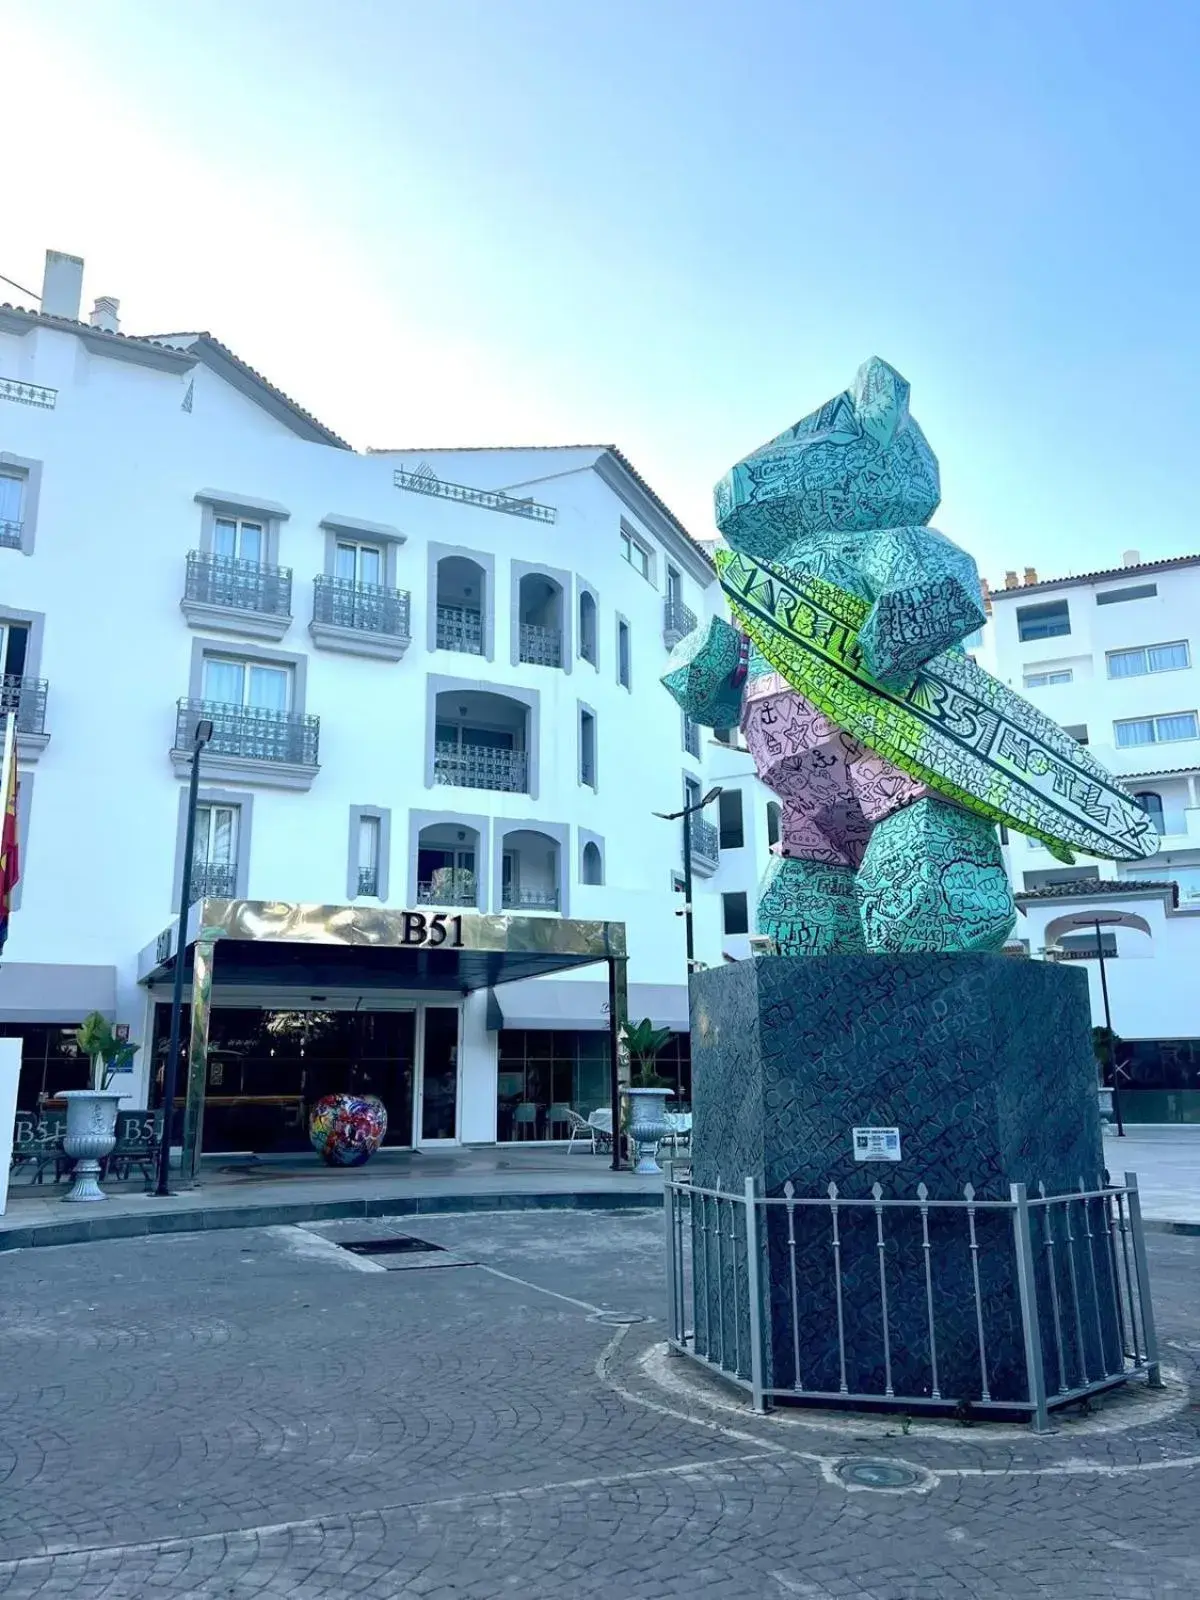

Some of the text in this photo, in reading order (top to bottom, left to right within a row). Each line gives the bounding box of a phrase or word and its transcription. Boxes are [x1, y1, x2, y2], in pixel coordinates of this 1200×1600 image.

[905, 670, 1000, 756] B51
[997, 727, 1111, 827] HOTEL
[401, 911, 464, 947] B51
[16, 1120, 62, 1143] B51
[125, 1118, 165, 1141] B51
